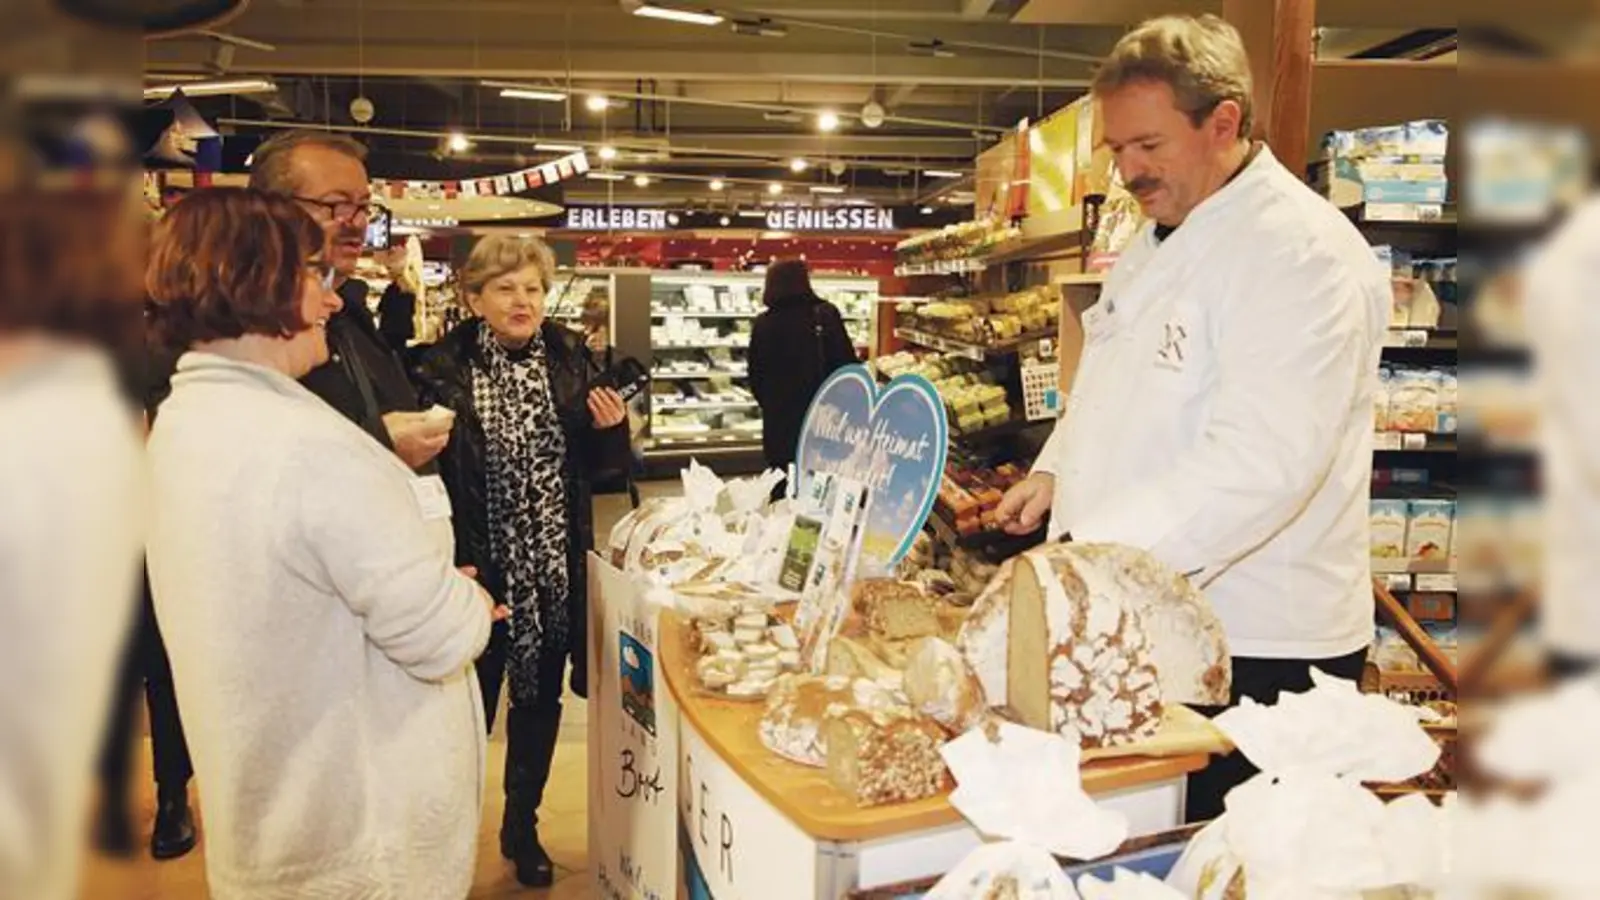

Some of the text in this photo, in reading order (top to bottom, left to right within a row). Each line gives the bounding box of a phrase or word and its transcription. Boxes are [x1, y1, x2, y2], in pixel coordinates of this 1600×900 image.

[568, 208, 666, 229] ERLEBEN
[766, 208, 894, 230] GENIESSEN
[871, 417, 930, 462] Heimat
